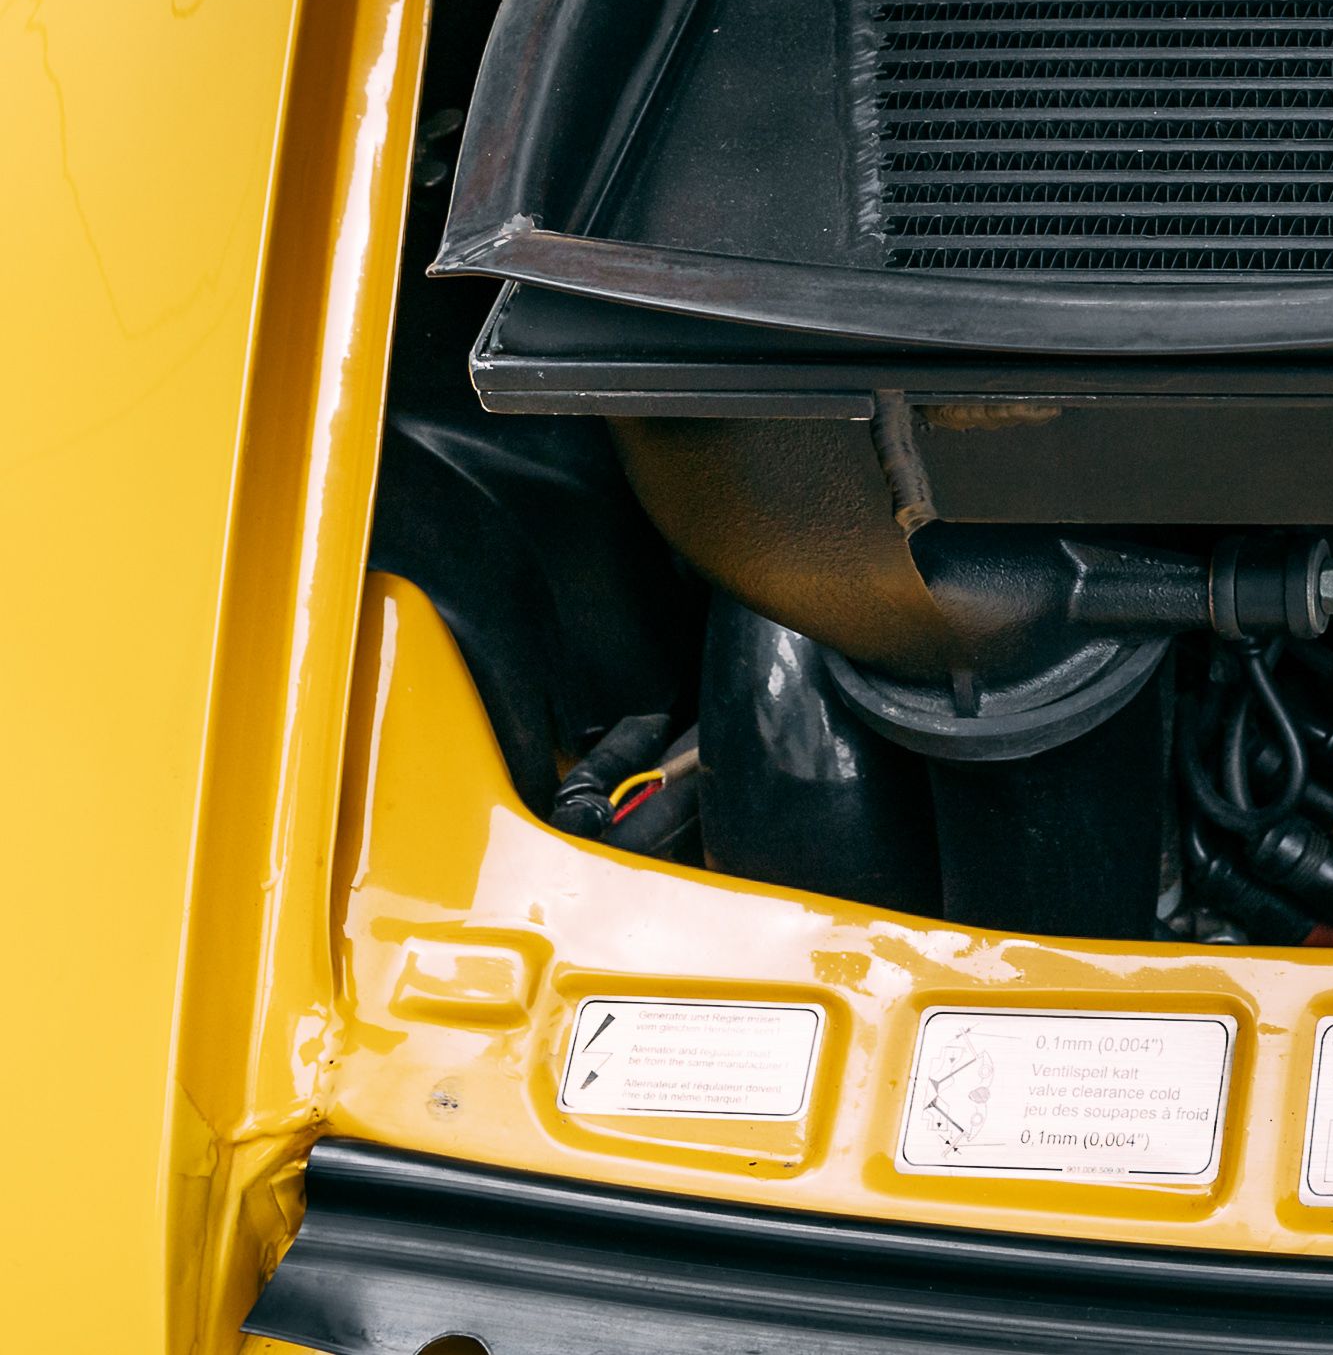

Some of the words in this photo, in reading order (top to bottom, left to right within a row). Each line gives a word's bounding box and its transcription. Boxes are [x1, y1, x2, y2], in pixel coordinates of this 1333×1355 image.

[1112, 1065, 1139, 1080] kalt
[1028, 1083, 1067, 1098] valve
[1072, 1084, 1145, 1100] clearance
[1149, 1086, 1181, 1101] cold
[1022, 1103, 1047, 1119] jeu
[1051, 1103, 1079, 1117] des
[1083, 1107, 1157, 1122] soupapes
[1176, 1107, 1210, 1122] froid
